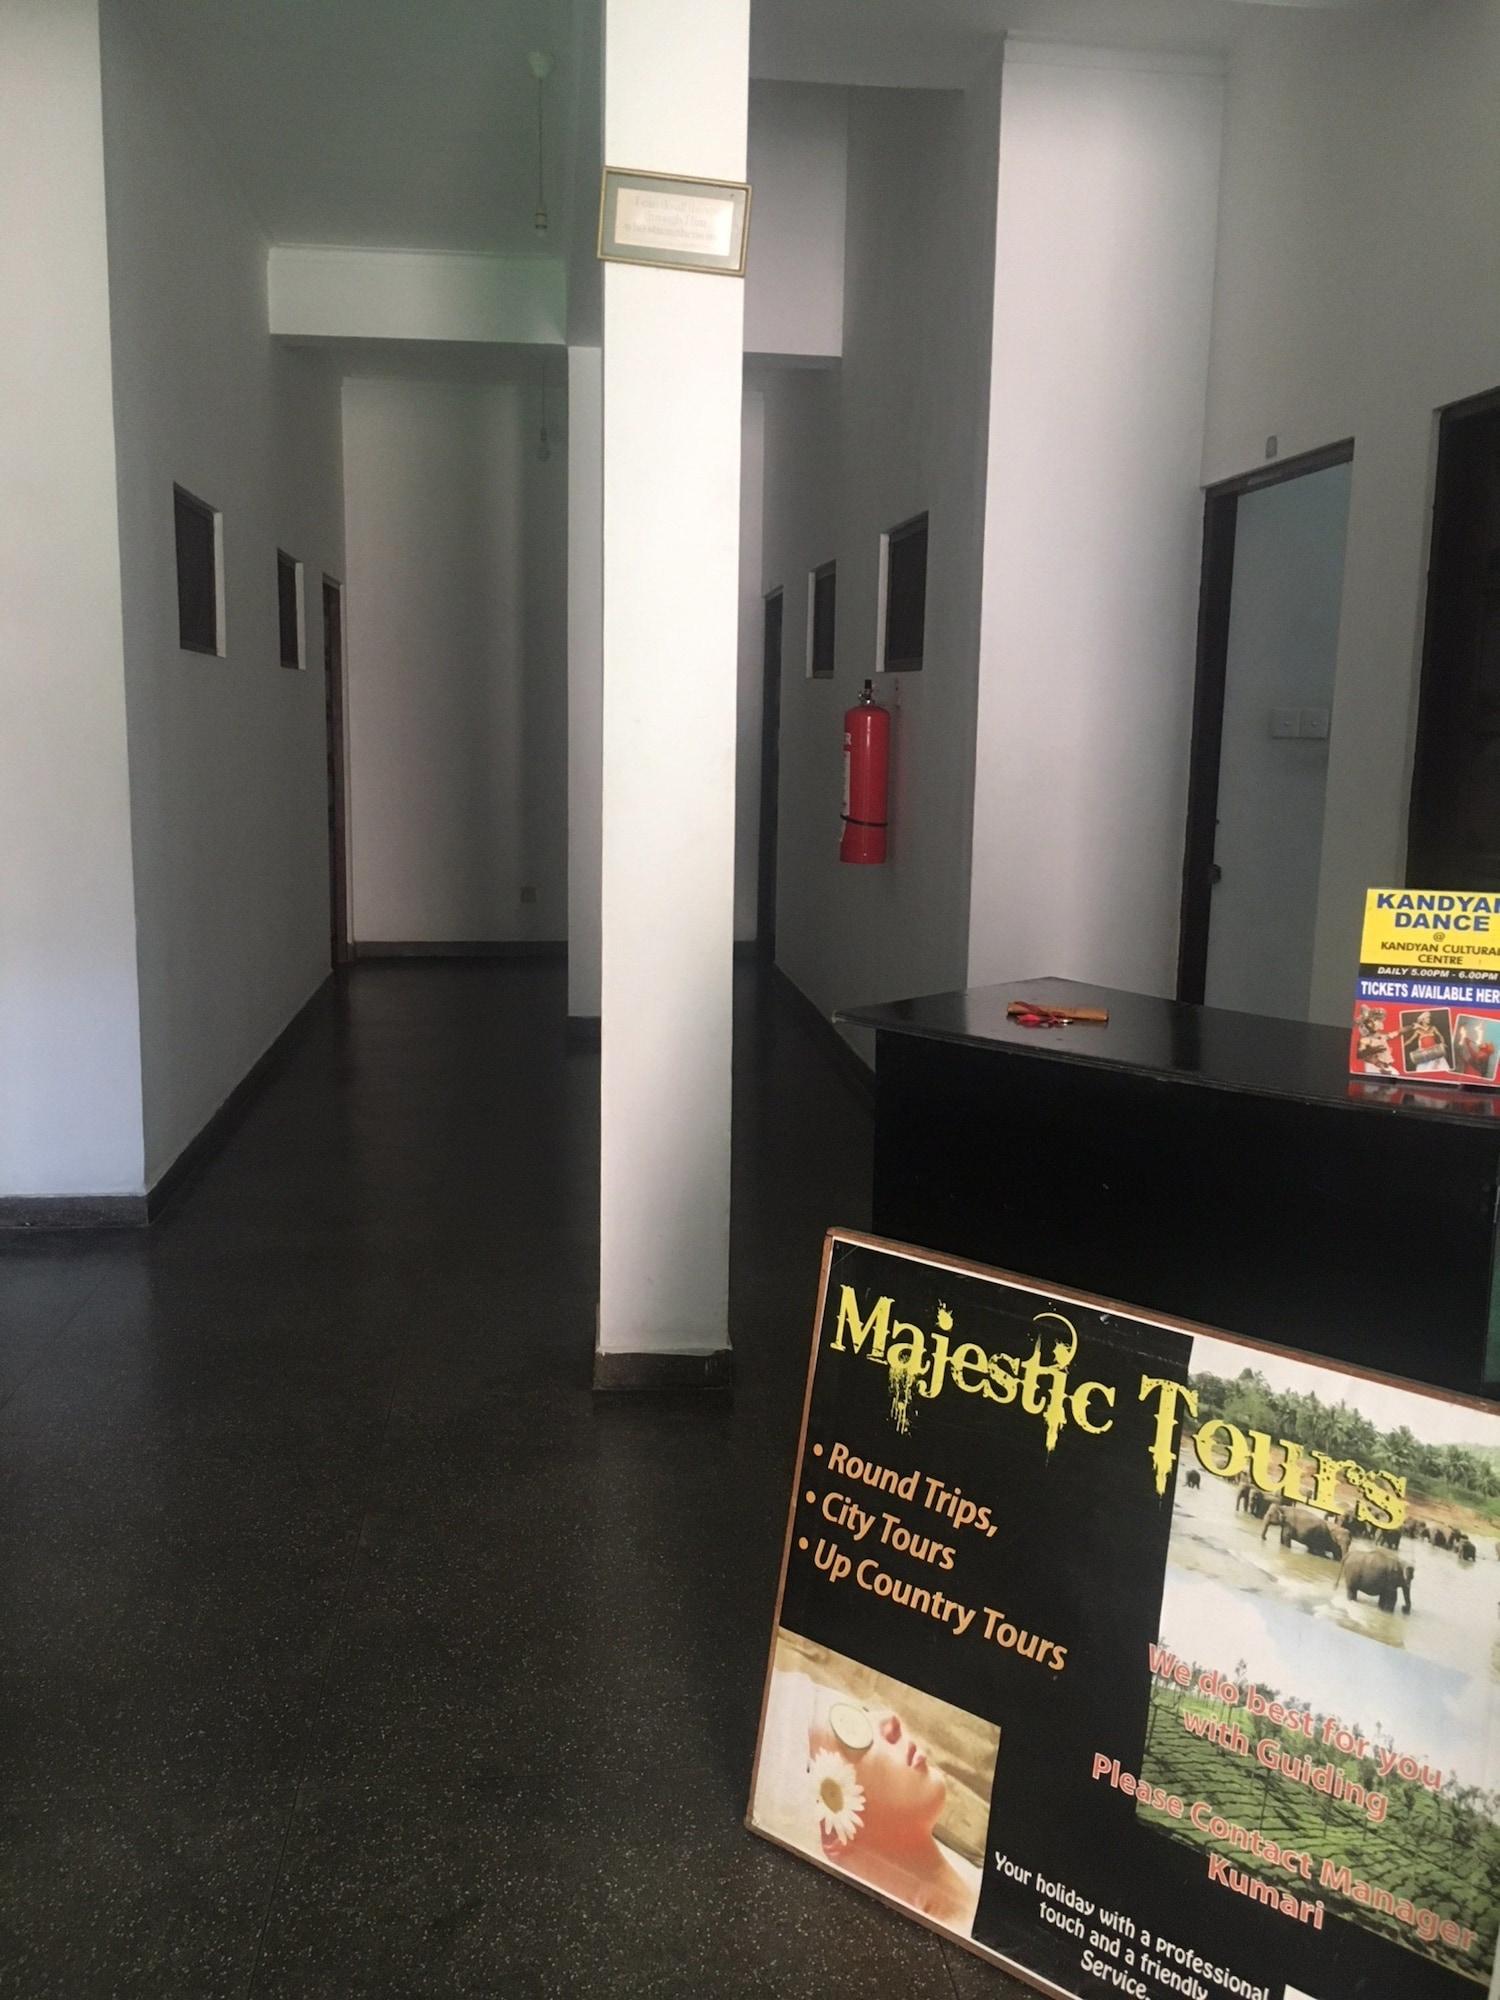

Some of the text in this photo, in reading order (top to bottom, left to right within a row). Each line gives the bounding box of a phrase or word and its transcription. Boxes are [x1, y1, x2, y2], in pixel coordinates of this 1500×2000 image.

[1381, 941, 1439, 953] KANDYAN
[1394, 912, 1490, 931] DANCE
[1417, 954, 1463, 965] CENTRE
[1433, 932, 1445, 942] @
[1360, 980, 1500, 1004] TICKETS AVAILABLE HER
[1377, 966, 1408, 976] DAILY
[1411, 968, 1450, 978] 5.00PM
[1458, 970, 1499, 981] 6.00PM
[830, 1284, 1409, 1531] Majestic Tours
[822, 1492, 957, 1571] City Tours
[828, 1442, 998, 1538] Round Trips,
[814, 1538, 1069, 1671] Up Country Tours
[1148, 1642, 1443, 1791] We do best for you
[1183, 1710, 1390, 1823] with Guiding
[1091, 1752, 1479, 1951] Please Contact Manager
[1207, 1853, 1326, 1931] Kumari
[995, 1851, 1270, 2000] Your holiday with a professional
[1039, 1901, 1208, 2000] touch and a friendly
